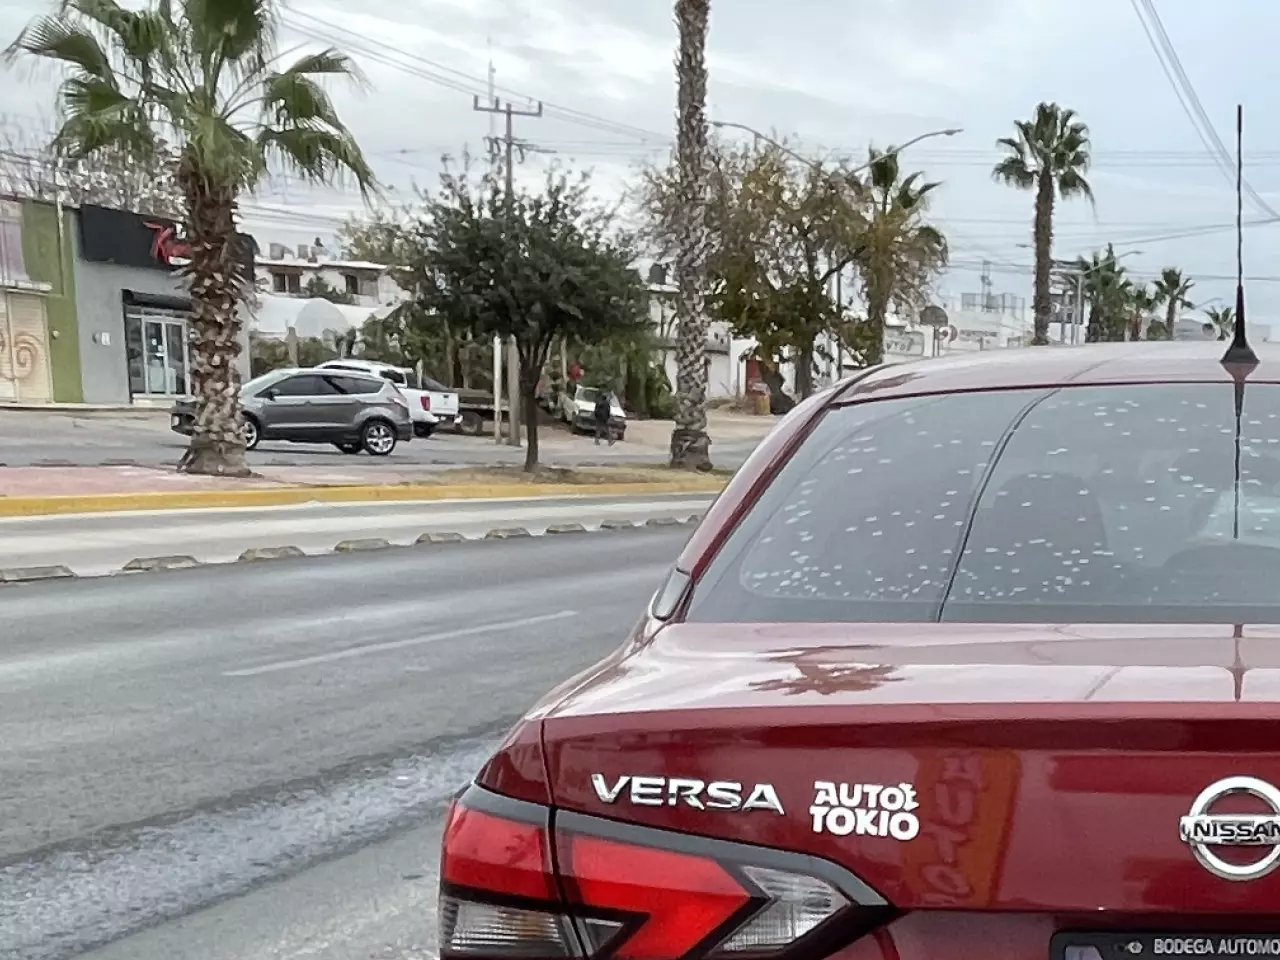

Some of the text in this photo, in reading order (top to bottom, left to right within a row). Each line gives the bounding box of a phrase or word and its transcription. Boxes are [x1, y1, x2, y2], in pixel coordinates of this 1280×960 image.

[591, 774, 785, 815] VERSA
[809, 806, 920, 841] TOKIO
[1153, 939, 1213, 954] BODEGA
